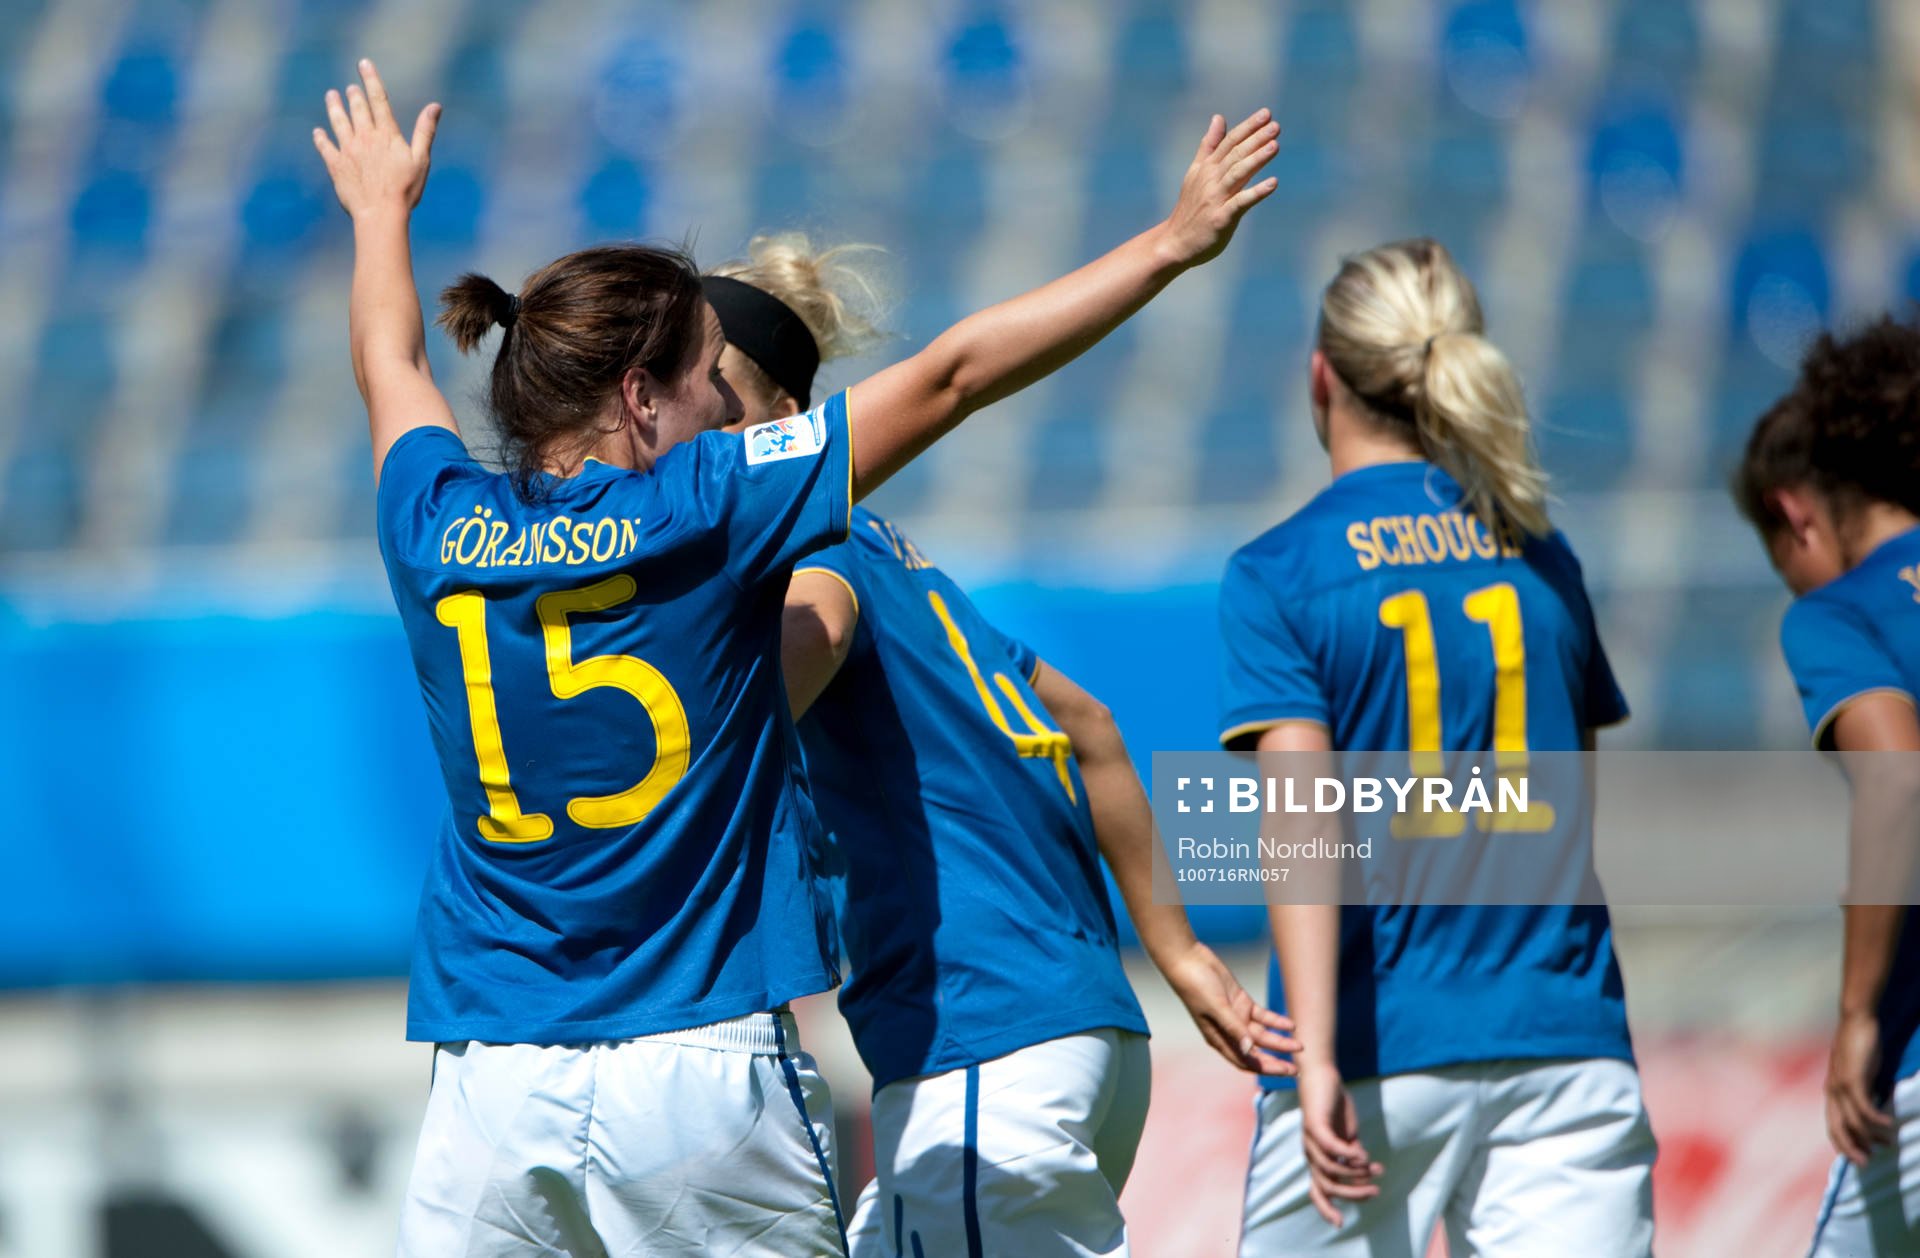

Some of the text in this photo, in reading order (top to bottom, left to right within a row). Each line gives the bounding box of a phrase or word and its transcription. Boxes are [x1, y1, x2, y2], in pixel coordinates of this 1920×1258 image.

[441, 505, 642, 568] GÖRANSSON
[436, 574, 691, 842] 15
[1379, 582, 1556, 840] 11
